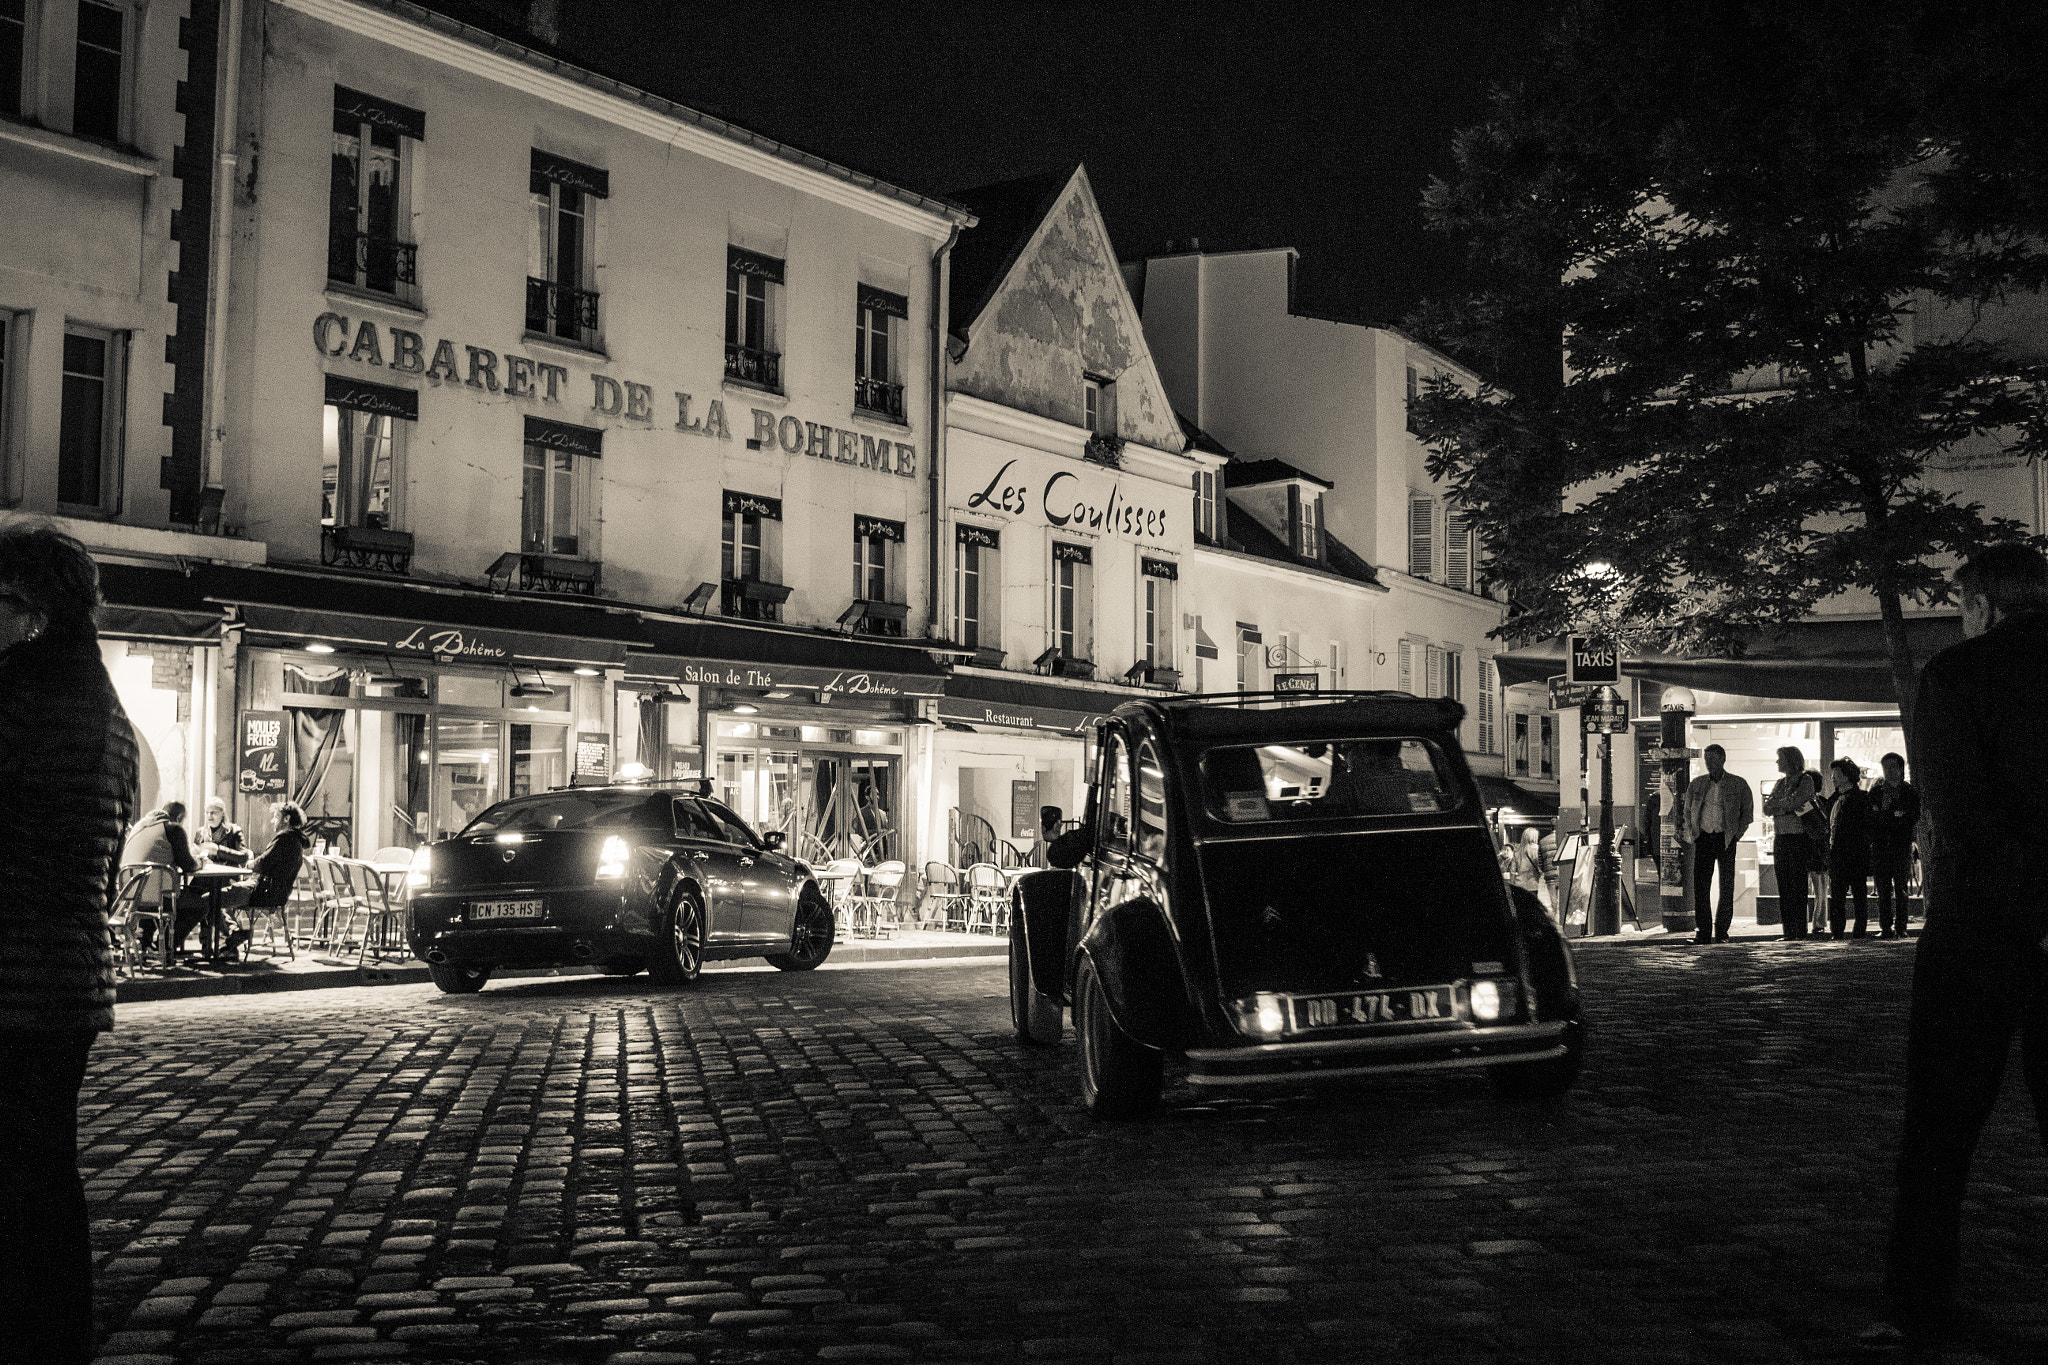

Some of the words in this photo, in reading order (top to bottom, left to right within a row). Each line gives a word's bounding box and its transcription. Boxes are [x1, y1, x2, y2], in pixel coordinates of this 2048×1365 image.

[312, 311, 567, 402] CABARET
[590, 373, 653, 422] DE
[674, 391, 733, 440] LA
[750, 408, 917, 479] BOHEME
[967, 458, 1027, 515] Les
[1043, 471, 1167, 537] Coulisses
[395, 626, 425, 650] La
[429, 630, 506, 657] Bohème
[1575, 652, 1614, 667] TAXIS
[685, 665, 720, 684] Salon
[726, 668, 741, 685] de
[747, 671, 771, 687] Thé
[823, 672, 844, 692] La
[847, 673, 899, 695] Bohème
[1594, 704, 1614, 712] PLACE
[1667, 703, 1685, 711] TAXIS
[985, 709, 1033, 727] Restaurant
[247, 720, 281, 736] MOULES
[246, 734, 278, 747] FRITES
